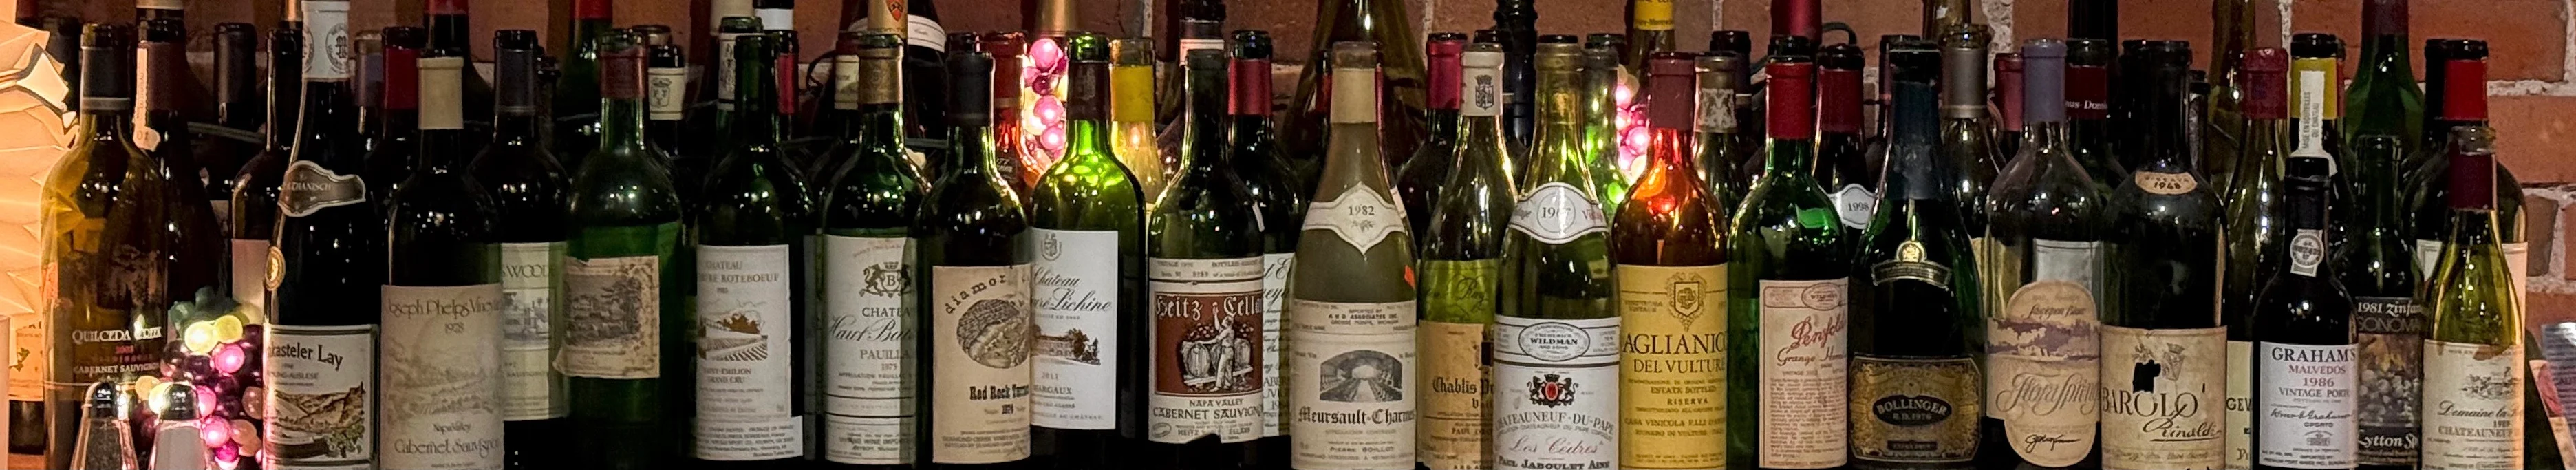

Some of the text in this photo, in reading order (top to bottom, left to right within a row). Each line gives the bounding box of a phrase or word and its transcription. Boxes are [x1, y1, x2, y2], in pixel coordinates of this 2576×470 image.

[1349, 205, 1375, 215] 1982
[1847, 202, 1869, 211] 1998
[888, 275, 895, 287] B
[426, 299, 469, 319] Phelps
[1156, 295, 1203, 321] Heitz
[2357, 301, 2383, 314] 1981
[72, 330, 131, 344] QUILCEDA
[1530, 337, 1578, 345] WILDMAN
[318, 345, 343, 371] Lay
[1633, 358, 1663, 373] DEL
[2288, 364, 2346, 375] MALVEDOS
[1432, 376, 1477, 395] Chablis
[2303, 377, 2335, 387] 1986
[969, 385, 987, 400] Red
[2279, 387, 2322, 398] VINTAGE
[1189, 398, 1244, 407] NAPA VALLEY
[1876, 398, 1949, 416] BOLLINGER
[2103, 387, 2198, 418] BAROLO
[2437, 400, 2493, 418] Domaine
[1153, 407, 1209, 420] CABERNET
[394, 438, 451, 454] Cabernet
